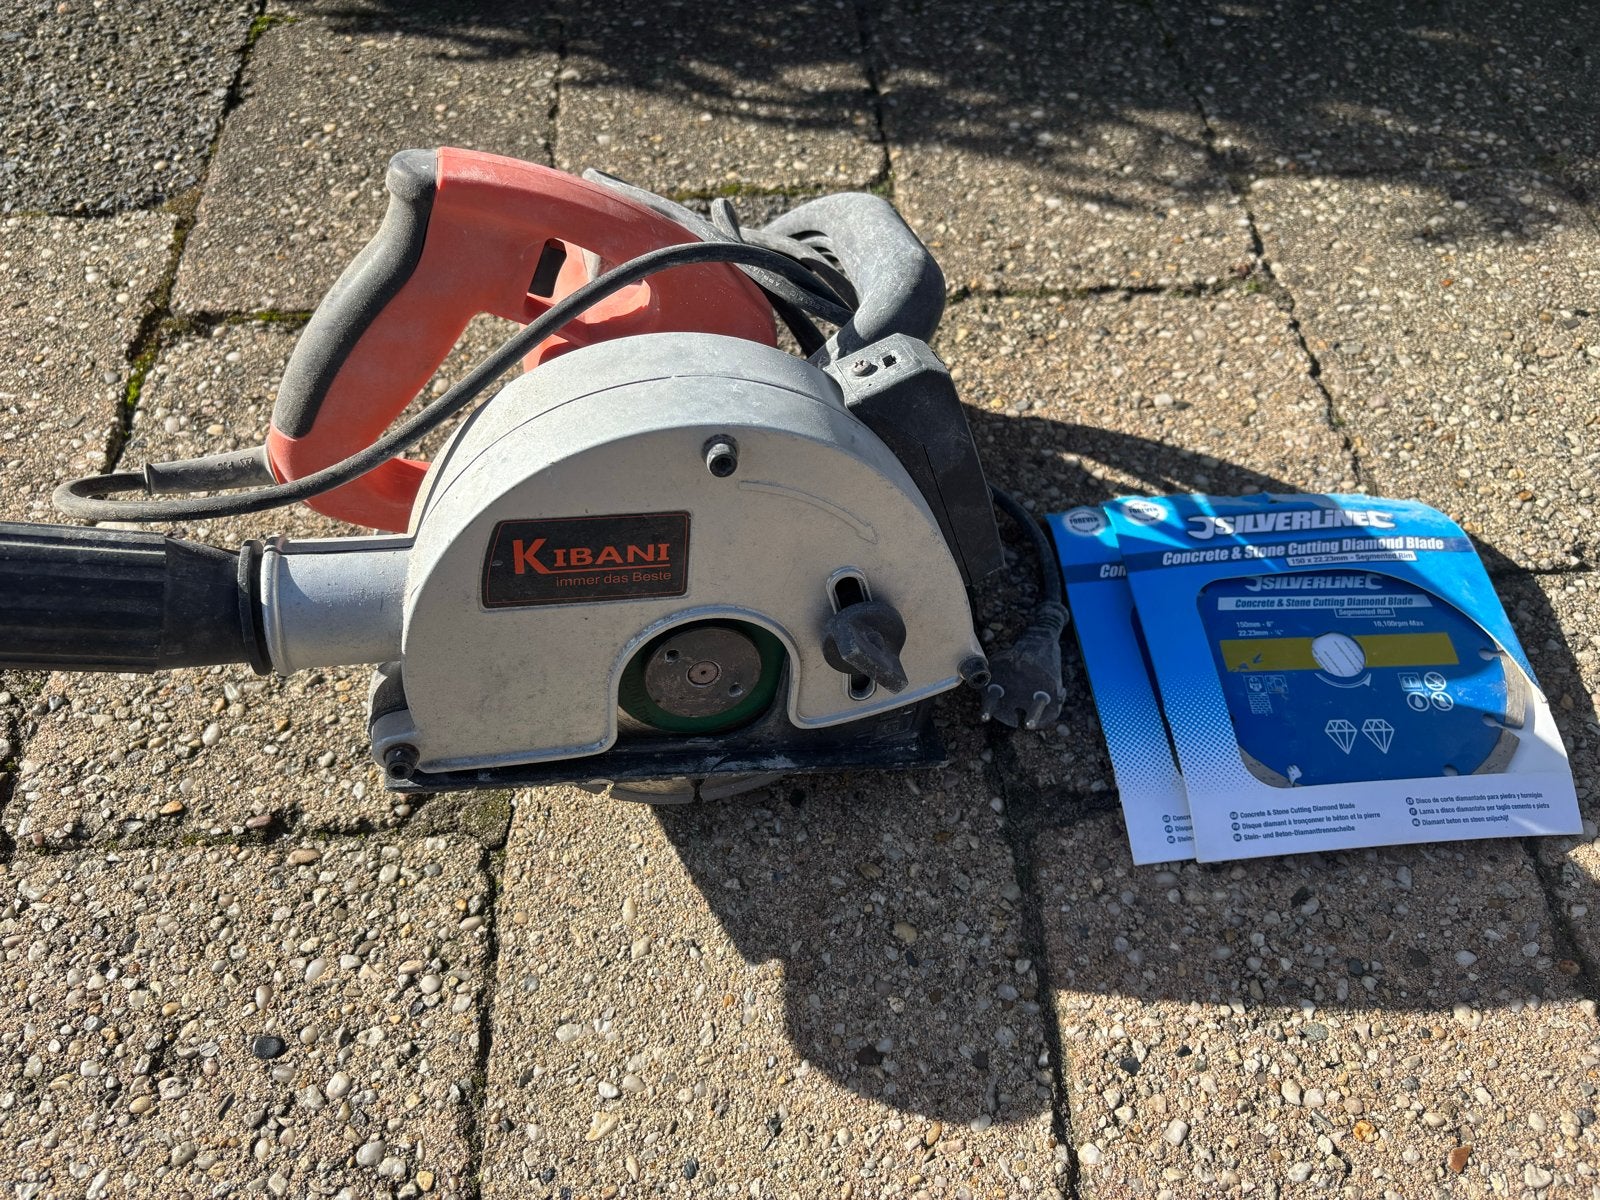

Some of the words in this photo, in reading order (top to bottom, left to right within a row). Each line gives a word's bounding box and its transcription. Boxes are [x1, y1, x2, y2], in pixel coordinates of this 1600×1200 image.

[1069, 516, 1098, 525] FOREVER
[512, 538, 670, 575] KIBANI
[1162, 549, 1228, 566] Concrete
[1231, 547, 1242, 560] &
[1244, 544, 1285, 559] Stone
[1288, 539, 1340, 555] Cutting
[1342, 536, 1404, 551] Diamond
[1406, 536, 1445, 550] Blade
[1291, 557, 1305, 565] 150
[1313, 555, 1348, 563] 22.23mm
[1355, 552, 1398, 561] Segmented
[1399, 551, 1414, 560] Rim
[1100, 564, 1126, 579] Con
[556, 576, 600, 587] immer
[603, 574, 628, 584] das
[632, 571, 672, 582] Beste
[1235, 598, 1275, 608] Concrete
[1276, 598, 1284, 608] &
[1285, 598, 1310, 607] Stone
[1312, 597, 1345, 608] Cutting
[1348, 597, 1387, 606] Diamond
[1388, 596, 1413, 606] Blade
[1339, 609, 1376, 617] Segmented
[1240, 810, 1266, 819] Concrete
[1272, 808, 1289, 816] Stone
[1290, 807, 1312, 815] Cutting
[1312, 804, 1338, 812] Diamond
[1339, 802, 1355, 810] Blade
[1418, 807, 1435, 815] Lama
[1440, 806, 1455, 814] disco
[1242, 822, 1262, 831] Disque
[1262, 819, 1287, 827] diamant
[1364, 811, 1381, 819] pierre
[1422, 818, 1446, 826] Diamant
[1262, 831, 1274, 839] und
